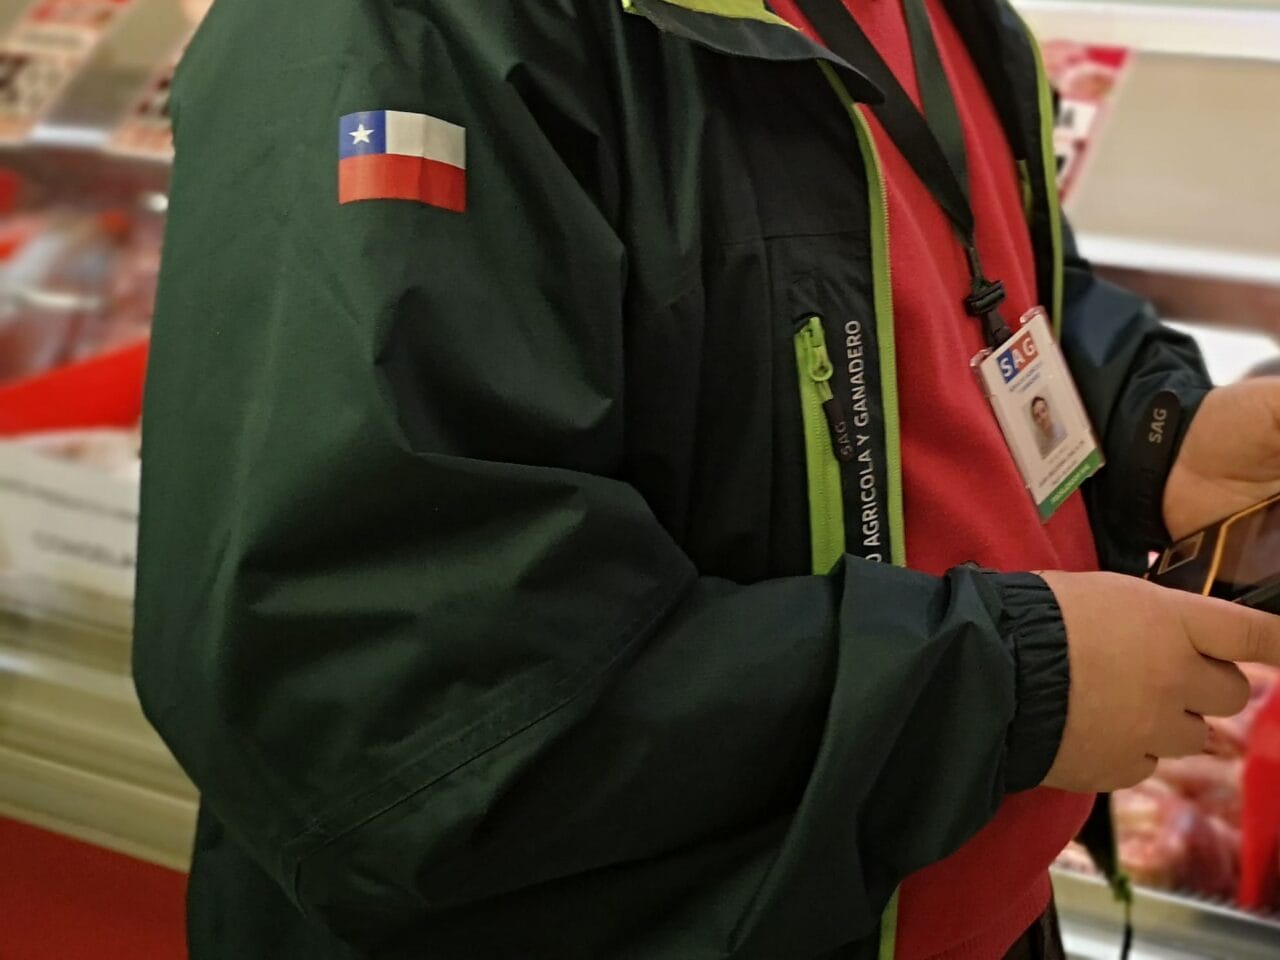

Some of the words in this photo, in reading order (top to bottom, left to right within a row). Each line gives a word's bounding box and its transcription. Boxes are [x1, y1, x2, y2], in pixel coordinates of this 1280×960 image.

[844, 320, 870, 428] GANADERO
[998, 339, 1037, 380] SAG
[834, 420, 853, 456] SAG
[855, 434, 870, 446] Y
[1148, 407, 1168, 444] SAG
[857, 448, 881, 546] AGRICOLA
